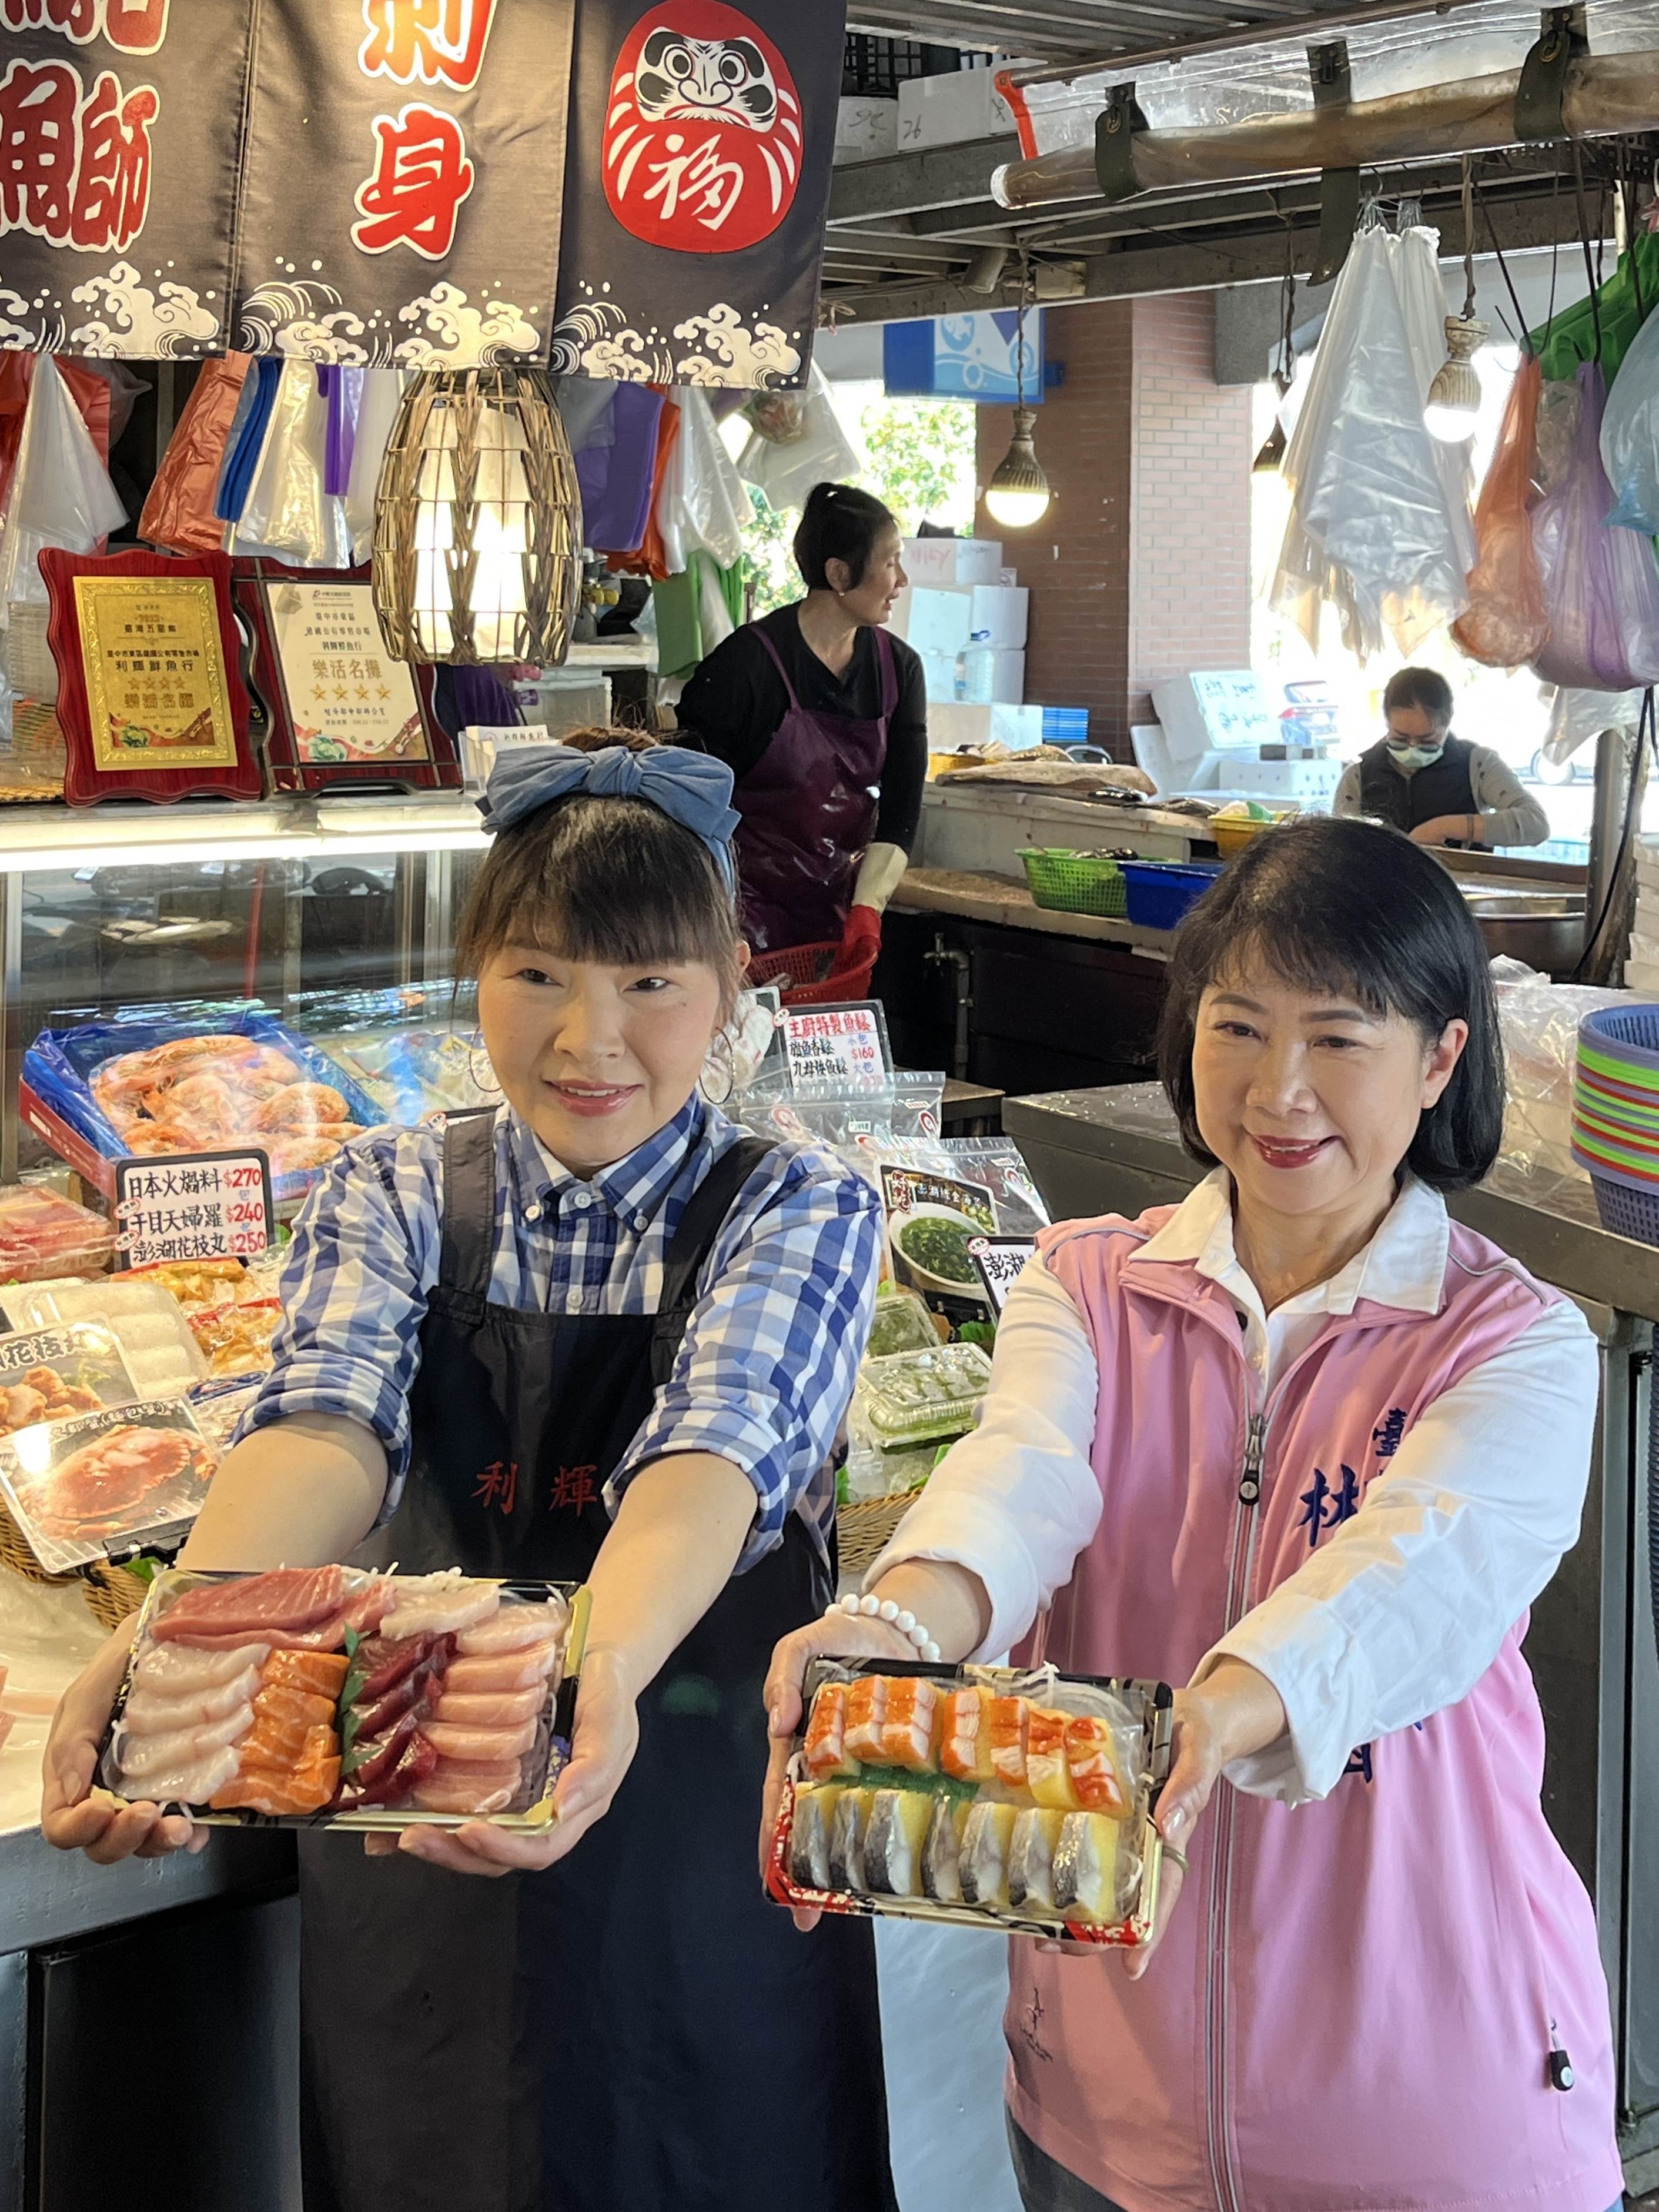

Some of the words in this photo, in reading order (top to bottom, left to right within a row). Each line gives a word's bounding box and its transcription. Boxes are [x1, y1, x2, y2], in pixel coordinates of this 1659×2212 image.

[644, 133, 744, 232] 福
[312, 659, 383, 679] 樂活名攤
[851, 1047, 875, 1060] $160
[223, 1168, 262, 1188] $270
[130, 1202, 224, 1235] 干貝天婦羅
[226, 1202, 263, 1223] $240
[133, 1232, 228, 1263] 澎湖花枝丸
[228, 1231, 266, 1254] $250
[471, 1461, 598, 1517] 利輝
